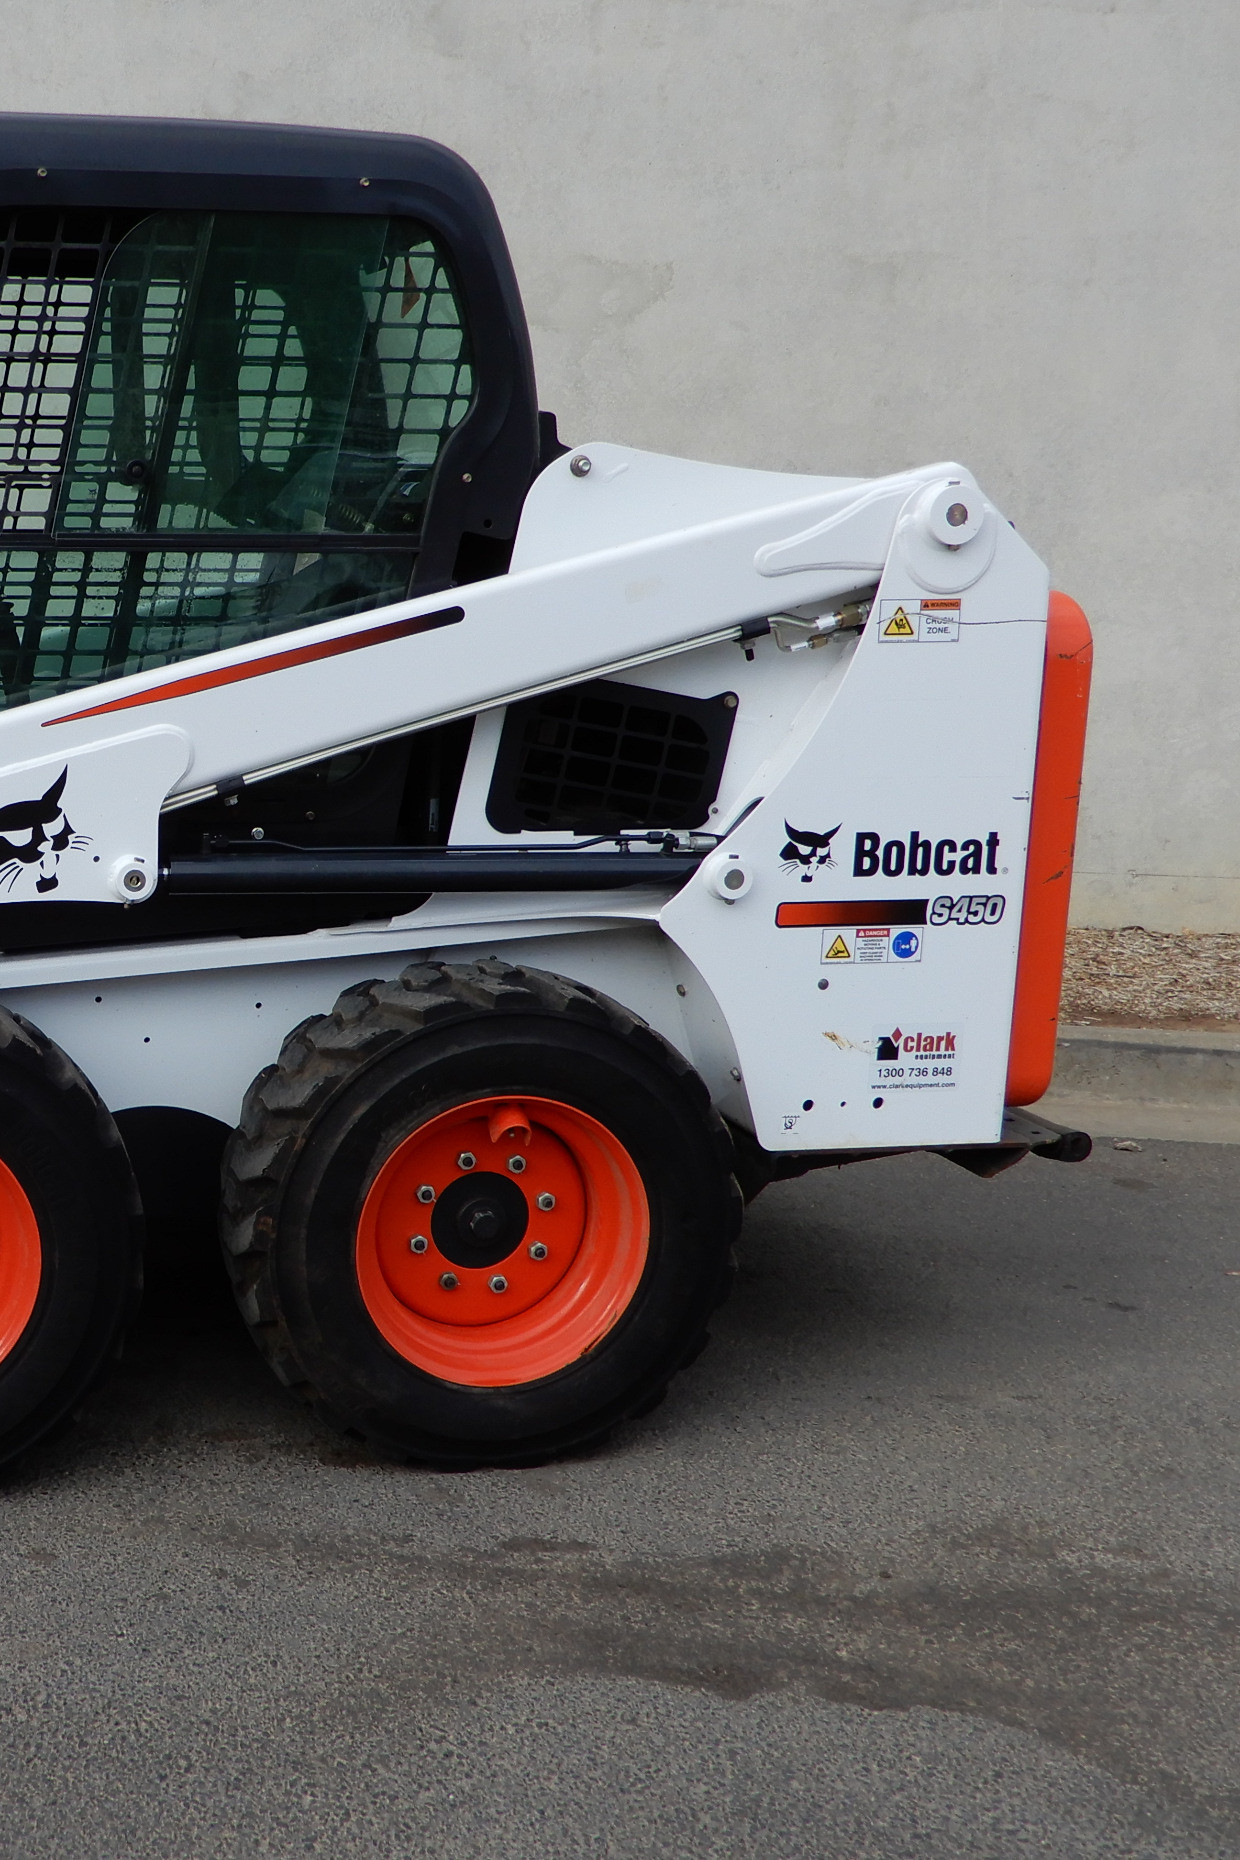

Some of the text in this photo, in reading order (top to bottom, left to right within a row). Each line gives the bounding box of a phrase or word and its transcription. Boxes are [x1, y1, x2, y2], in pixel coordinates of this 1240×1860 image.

[852, 830, 1000, 878] Bobcat
[930, 894, 1006, 926] S450
[902, 1031, 957, 1053] clark
[877, 1066, 953, 1078] 1300 736 848
